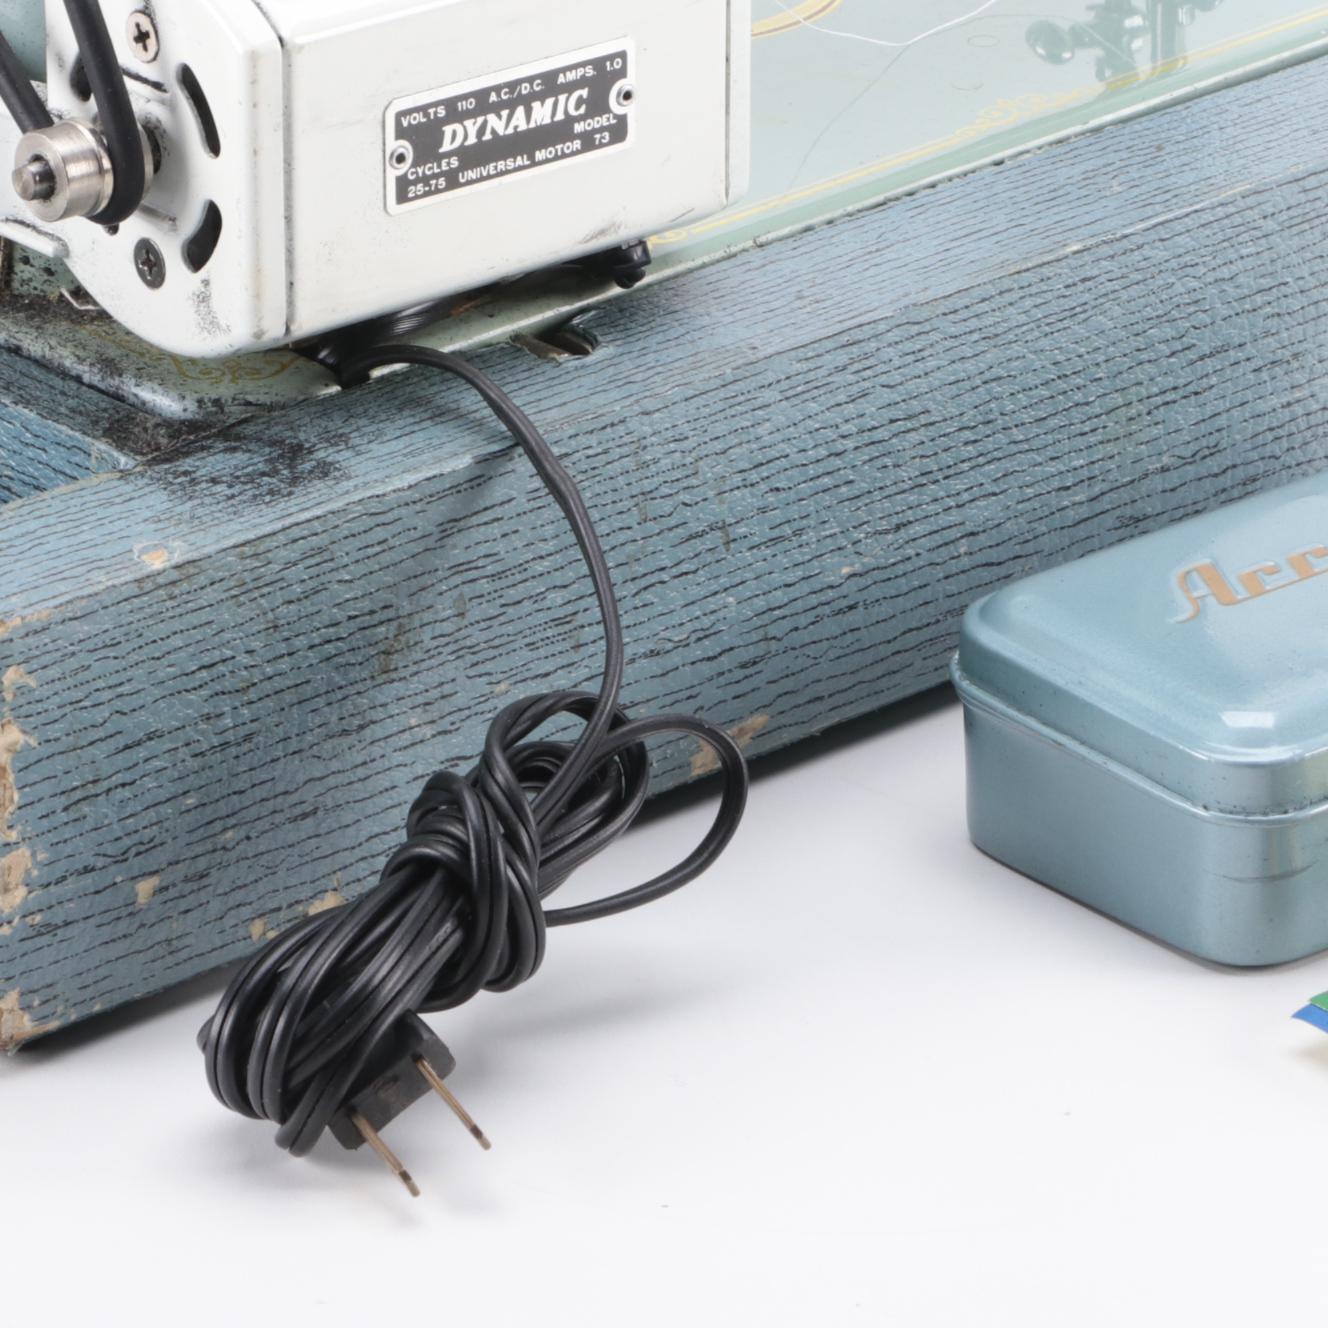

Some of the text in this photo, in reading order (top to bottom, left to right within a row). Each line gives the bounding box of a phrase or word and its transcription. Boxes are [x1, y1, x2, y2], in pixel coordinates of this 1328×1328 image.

[401, 105, 446, 127] VOLTS
[457, 99, 476, 112] 110
[557, 66, 597, 84] AMPS.
[605, 58, 622, 71] 1.0
[439, 88, 589, 152] DYNAMIC
[574, 113, 617, 133] MODEL
[407, 132, 610, 198] 25-75 UNIVERSAL MOTOR 73
[407, 157, 459, 180] CYCLES
